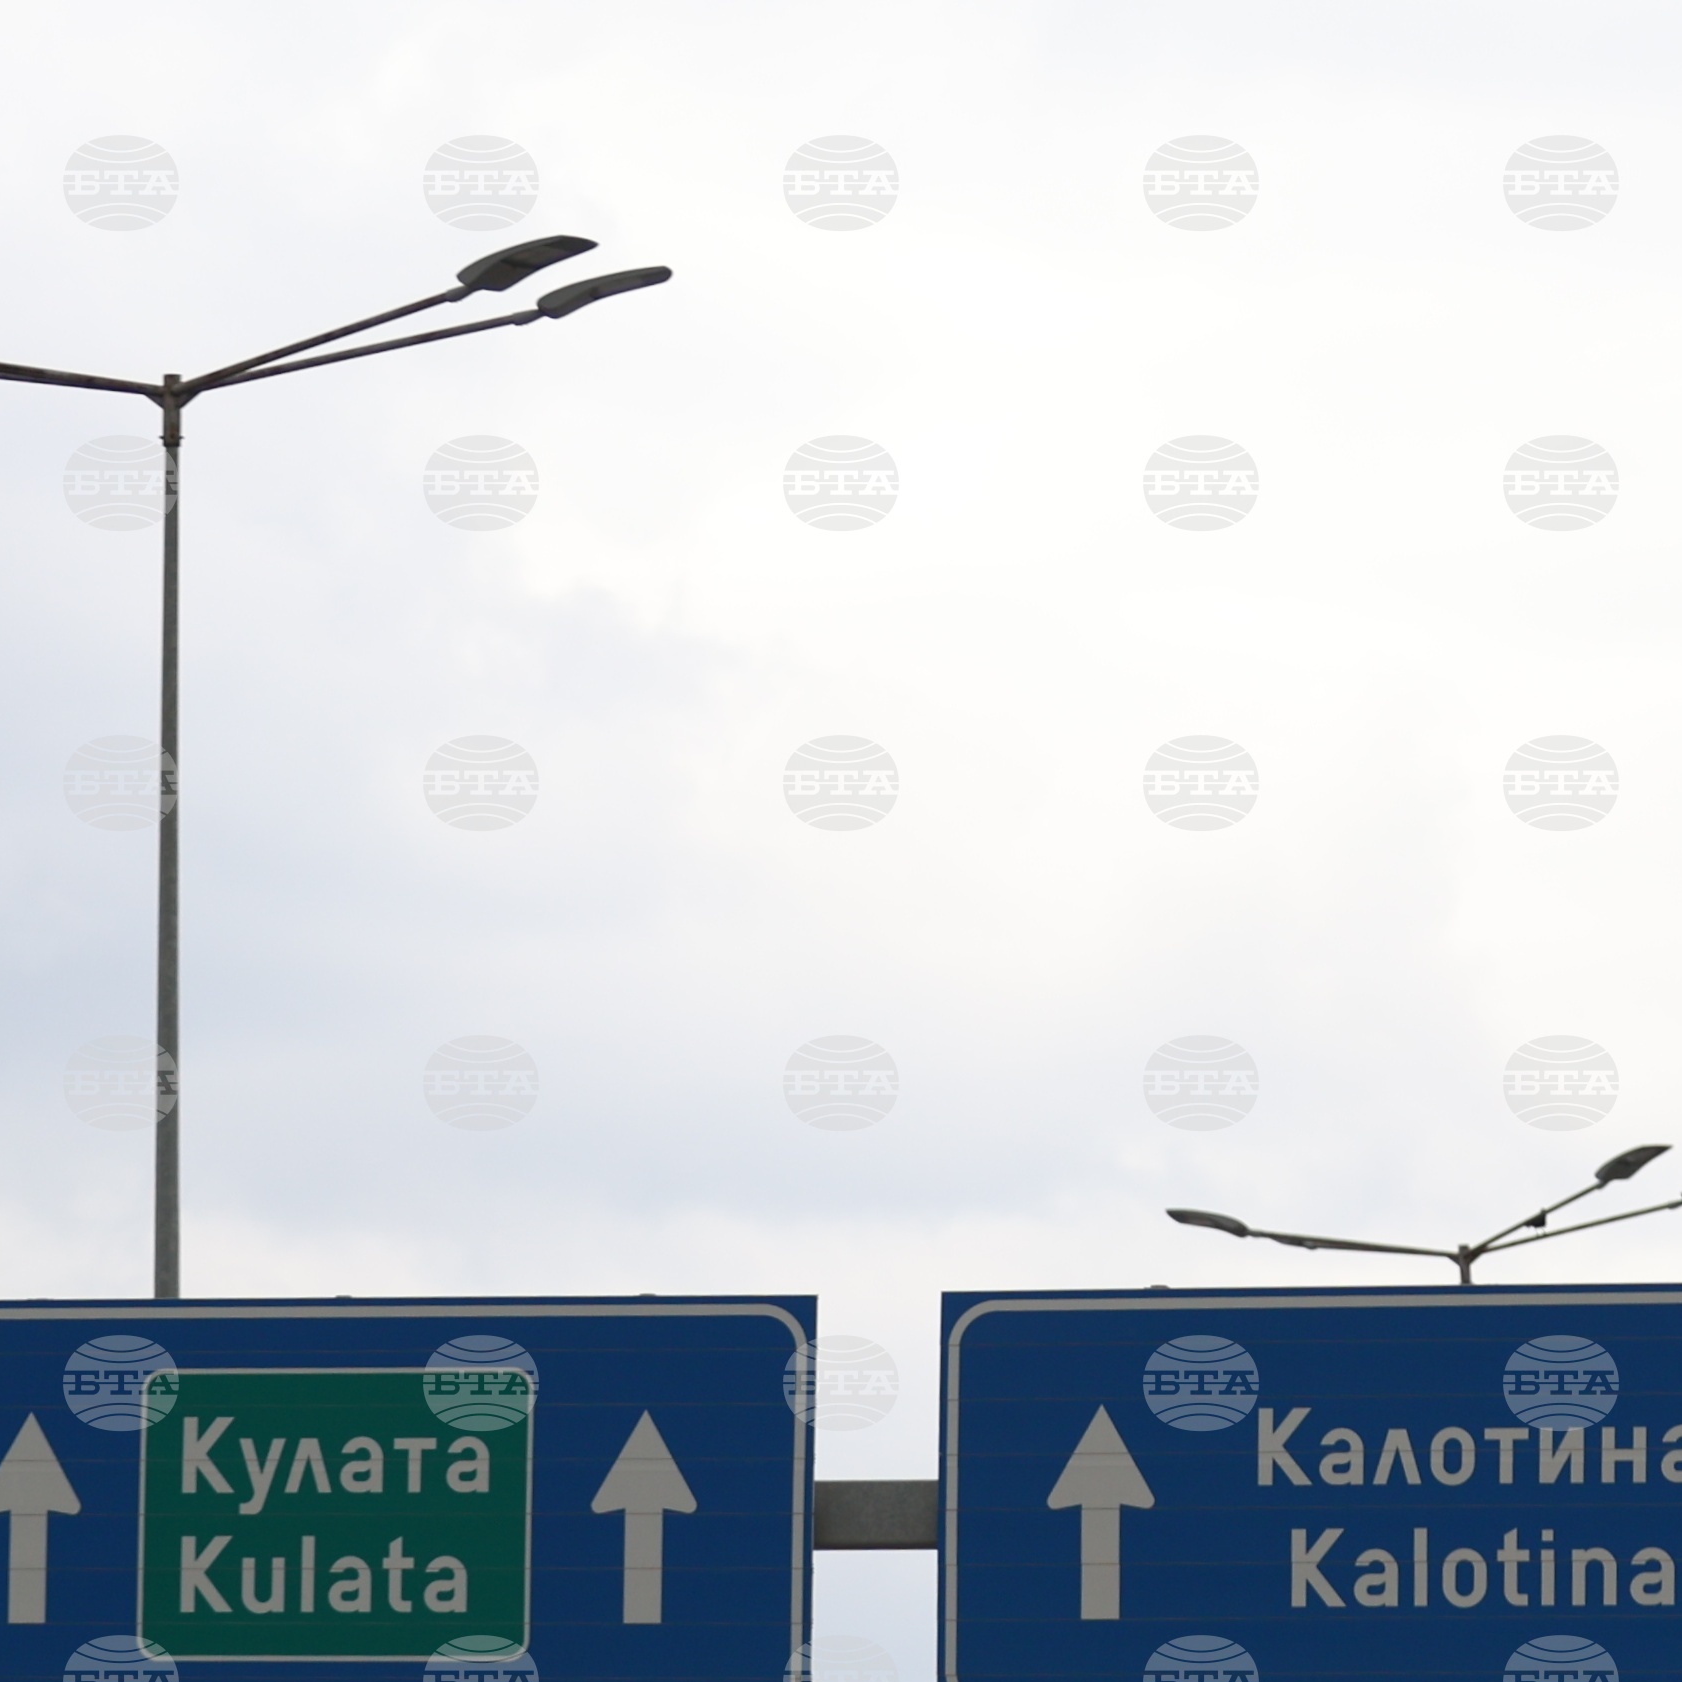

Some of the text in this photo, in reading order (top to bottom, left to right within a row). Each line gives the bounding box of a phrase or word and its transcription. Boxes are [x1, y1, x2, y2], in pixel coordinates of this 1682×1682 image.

[181, 1416, 491, 1514] Кулата
[179, 1535, 469, 1614] Kulata
[1289, 1527, 1677, 1608] Kalotina
